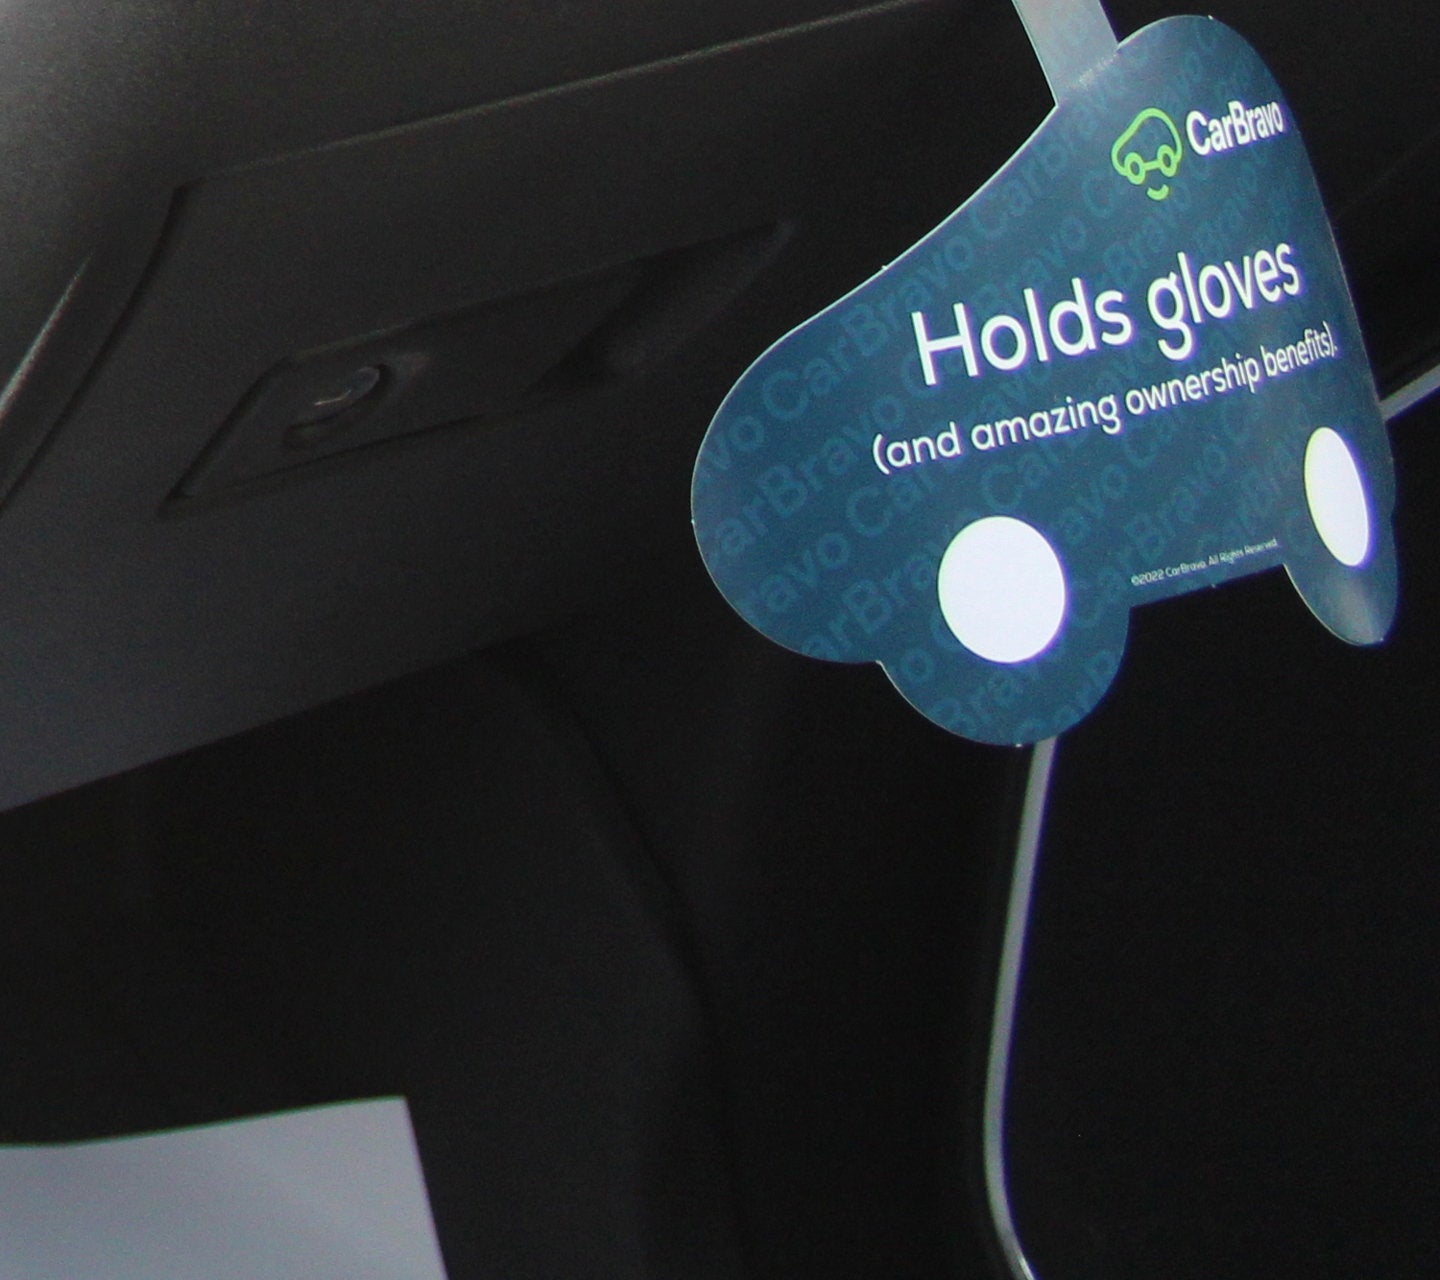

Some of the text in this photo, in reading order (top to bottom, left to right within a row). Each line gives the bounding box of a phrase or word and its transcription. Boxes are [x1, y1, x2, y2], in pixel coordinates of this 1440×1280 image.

[1185, 99, 1284, 156] CarBravo
[911, 242, 1300, 386] Holds gloves
[872, 420, 962, 475] (and
[970, 393, 1122, 435] amazing
[1125, 352, 1261, 416] ownership
